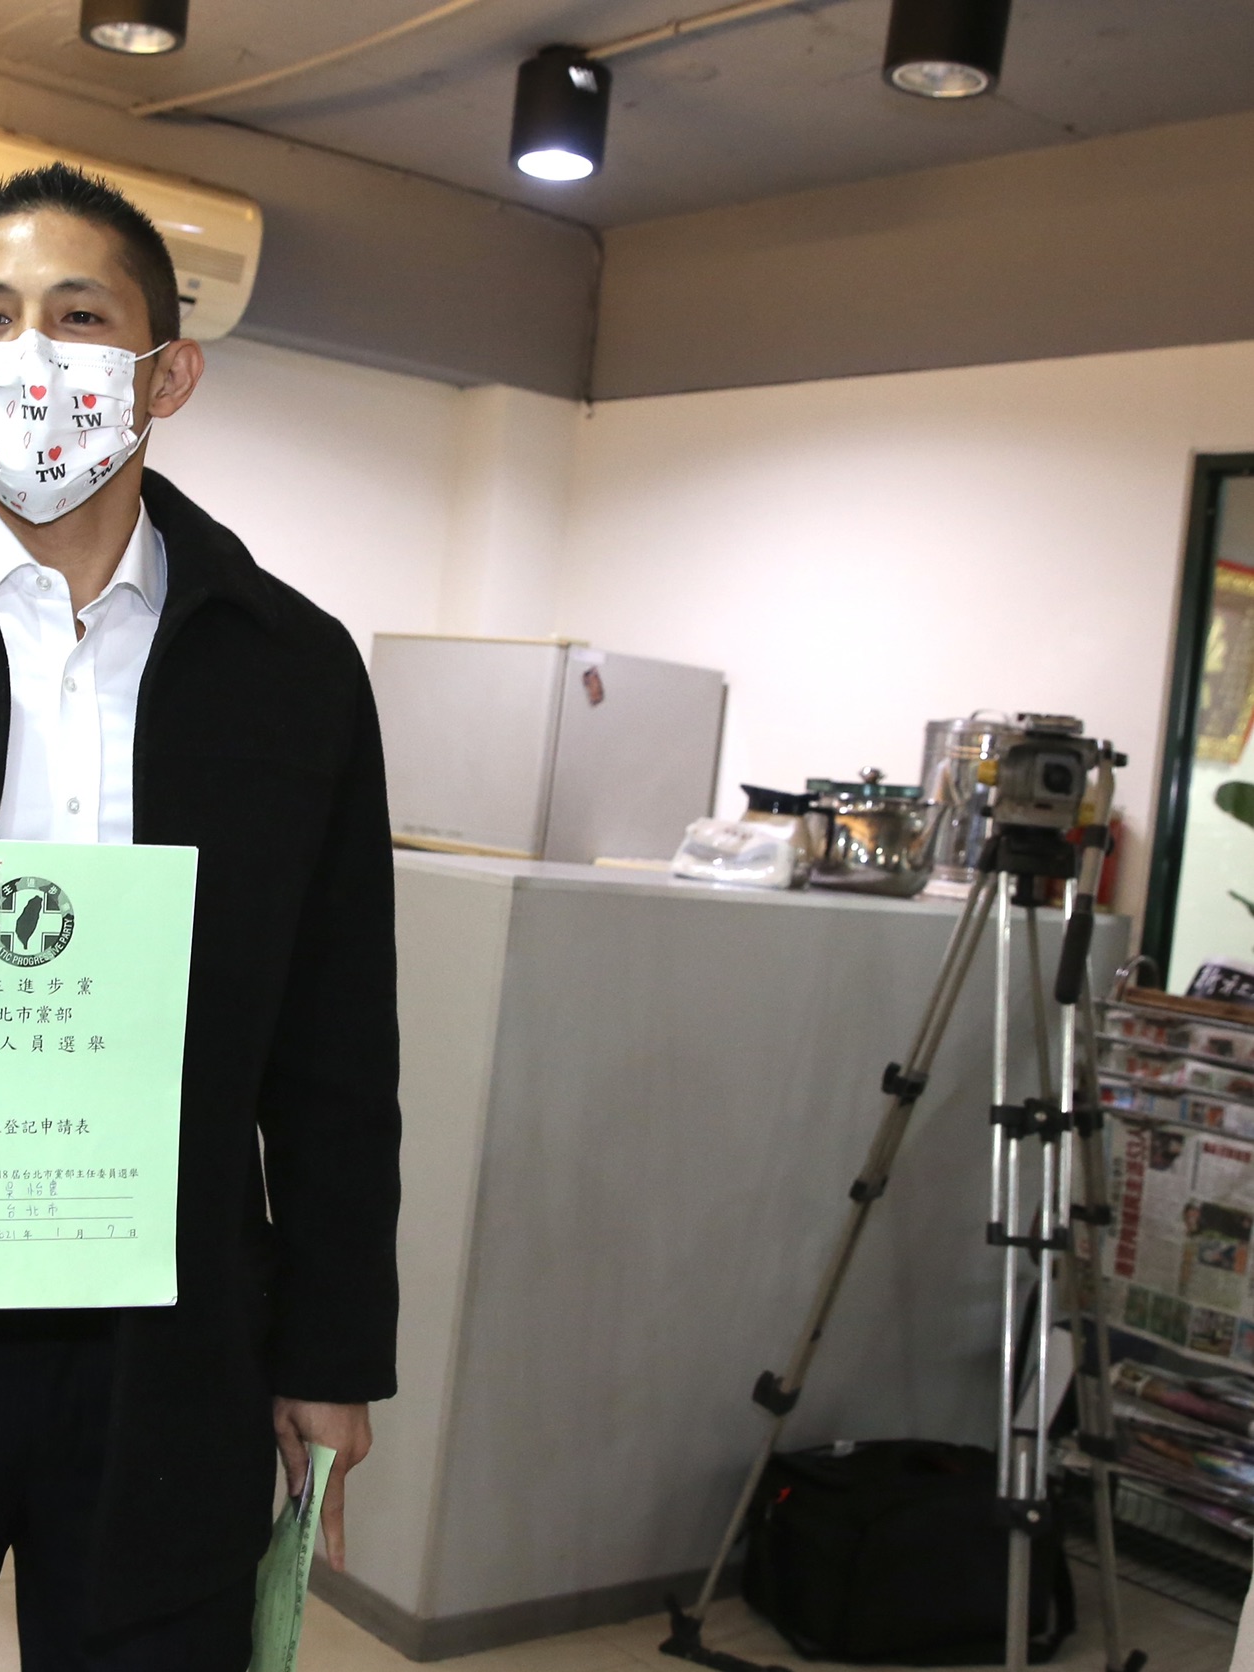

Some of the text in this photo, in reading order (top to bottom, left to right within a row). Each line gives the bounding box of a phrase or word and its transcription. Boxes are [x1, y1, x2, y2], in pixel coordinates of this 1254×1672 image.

[21, 404, 48, 421] TW
[72, 412, 103, 428] TW
[36, 463, 67, 482] TW
[61, 918, 73, 944] PARTY
